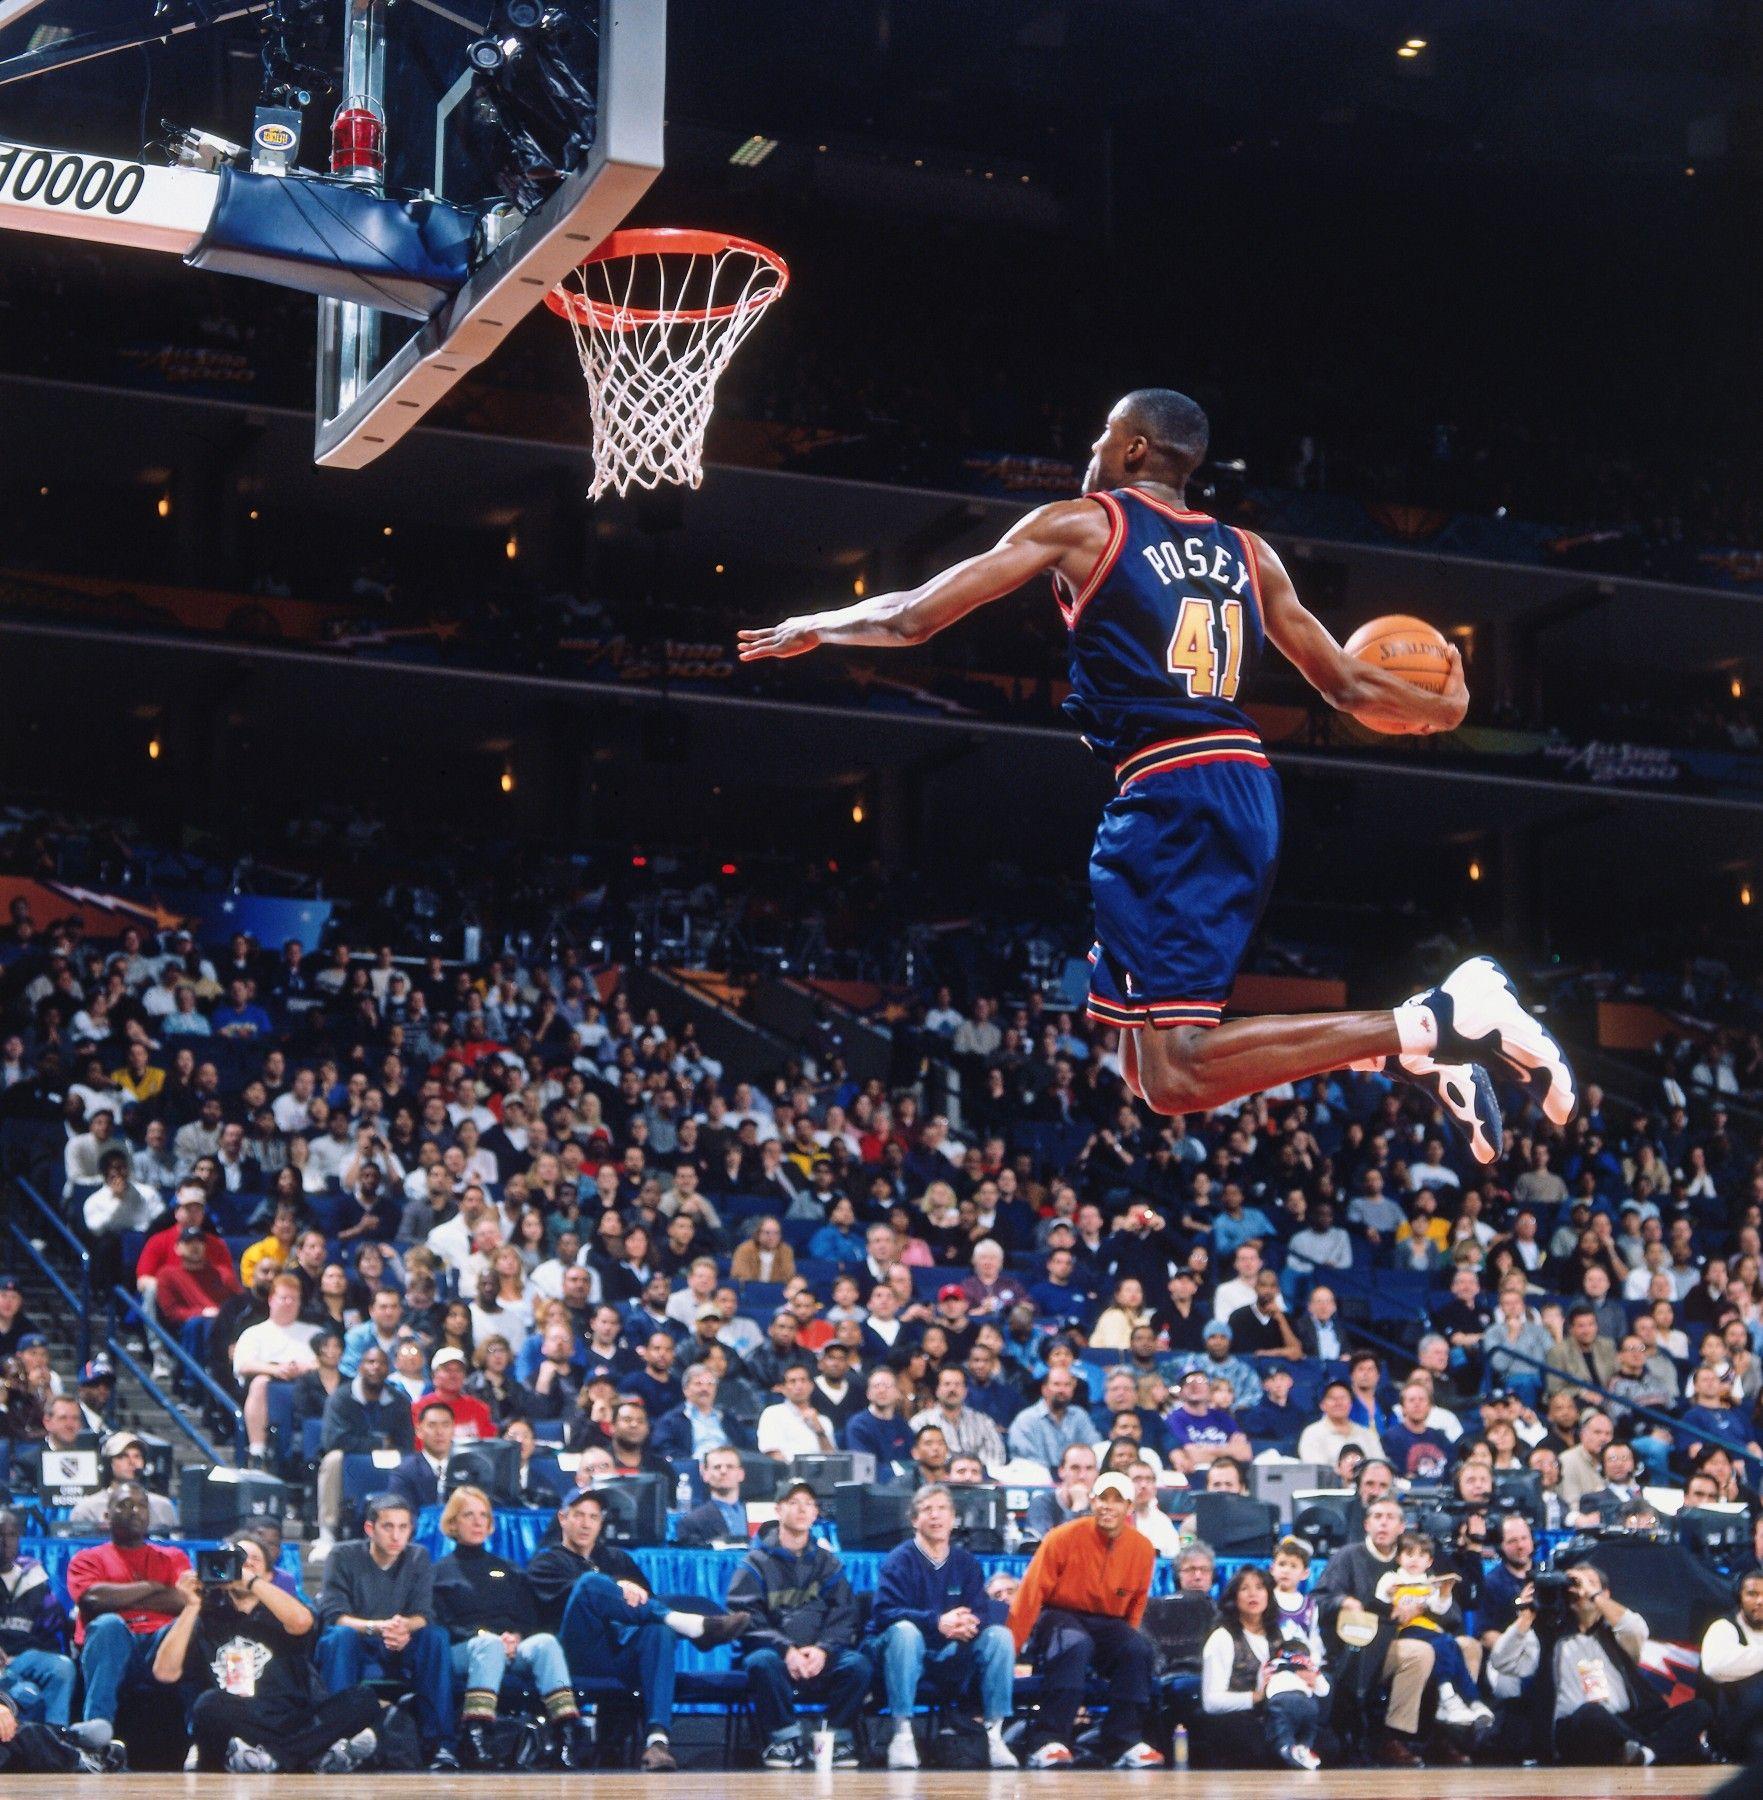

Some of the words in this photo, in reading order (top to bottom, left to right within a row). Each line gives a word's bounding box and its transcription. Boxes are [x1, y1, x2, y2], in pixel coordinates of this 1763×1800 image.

[0, 147, 145, 215] 10000
[1142, 537, 1250, 595] POSEY
[1167, 597, 1243, 702] 41
[1379, 642, 1449, 661] SPALDIN
